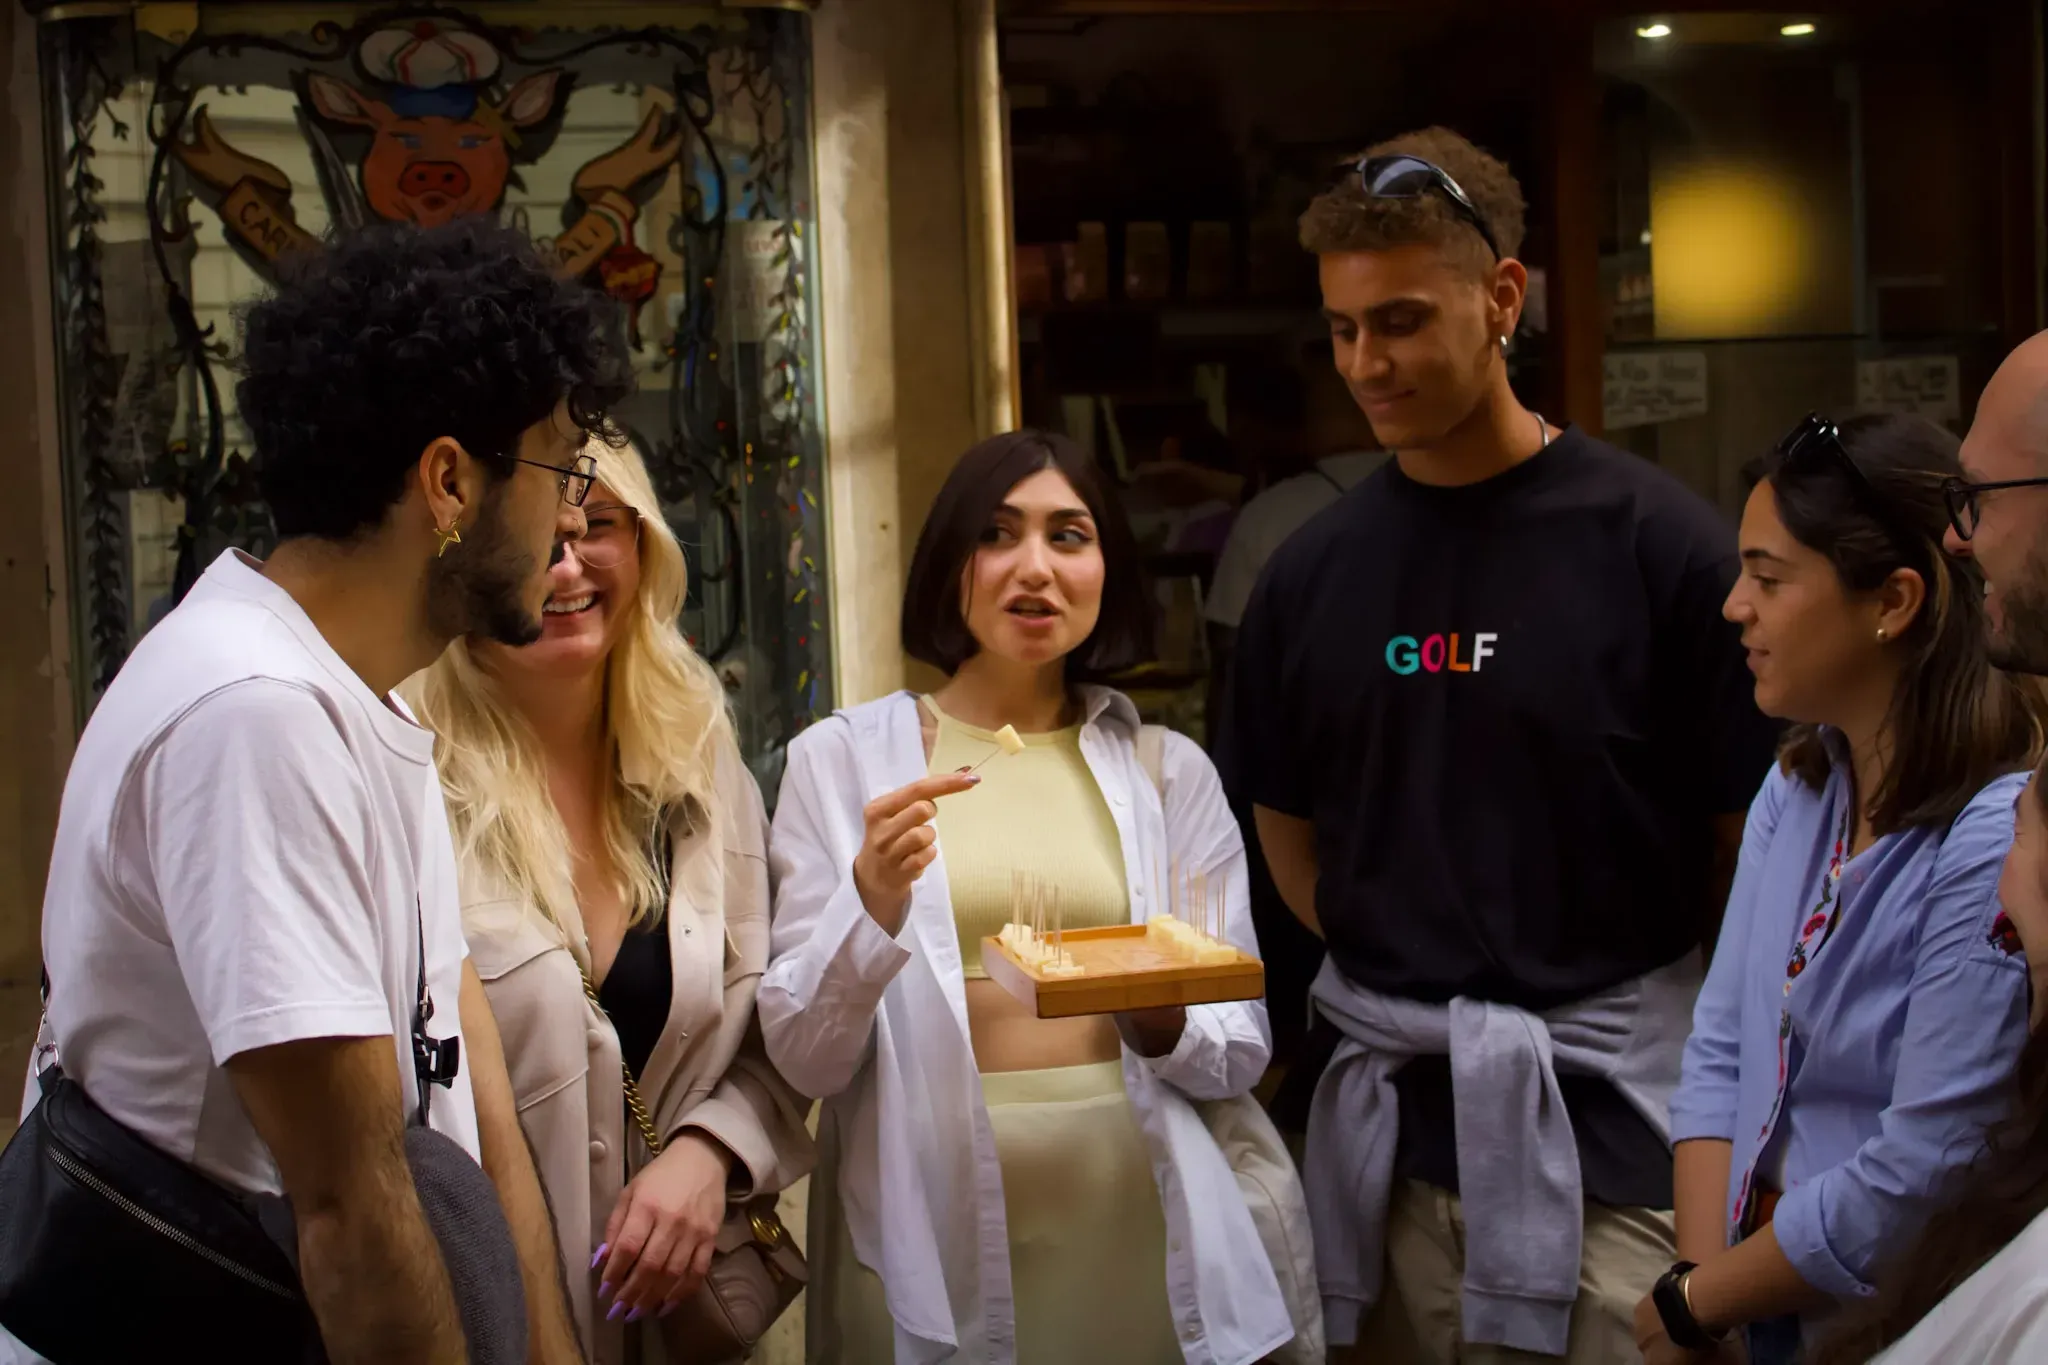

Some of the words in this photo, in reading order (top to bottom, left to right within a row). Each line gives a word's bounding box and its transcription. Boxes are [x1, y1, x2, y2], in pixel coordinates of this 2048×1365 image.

[239, 200, 290, 253] CAR
[557, 224, 601, 262] ALI
[1384, 632, 1498, 676] GOLF
